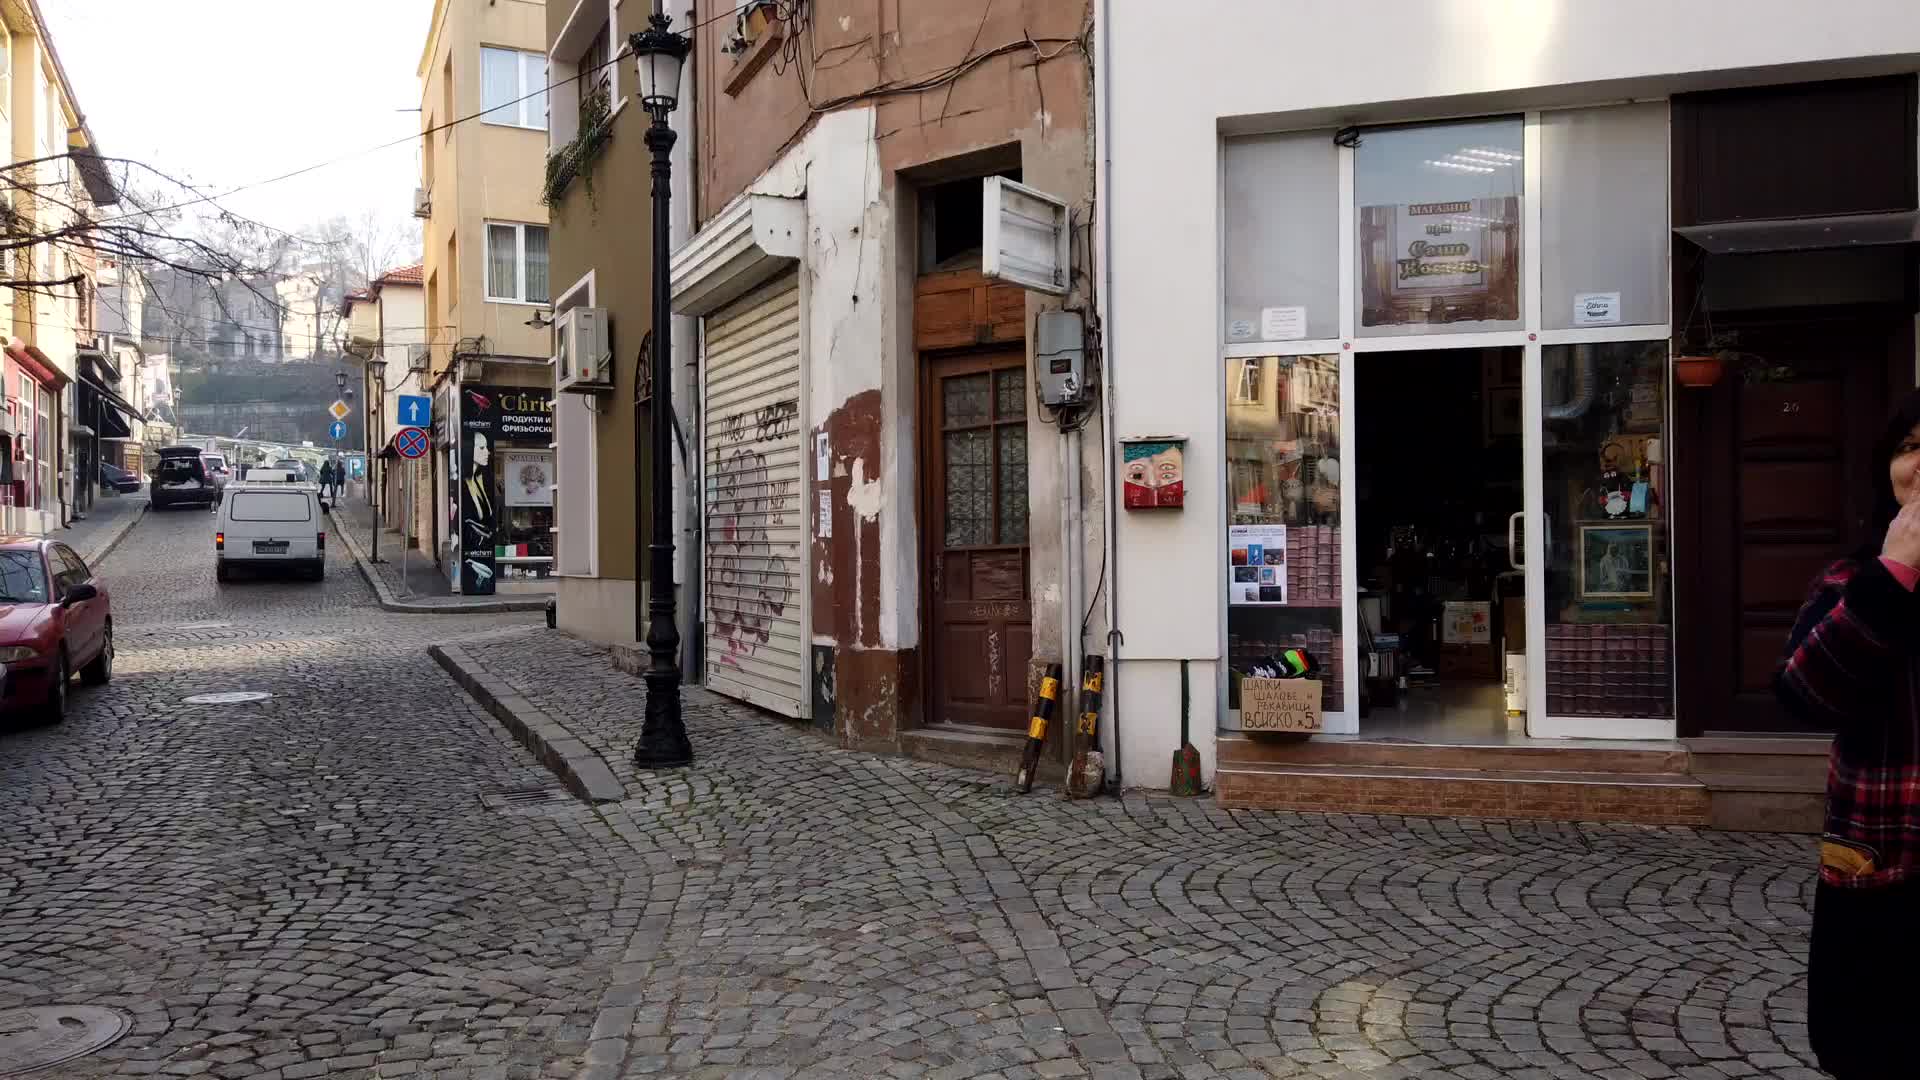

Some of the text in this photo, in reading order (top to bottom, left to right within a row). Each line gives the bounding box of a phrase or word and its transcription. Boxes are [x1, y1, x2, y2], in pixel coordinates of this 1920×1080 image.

[502, 415, 543, 423] ПРОДУКТИ
[1243, 680, 1281, 690] ШАПКИ
[1245, 712, 1293, 729] ВСИЧКО
